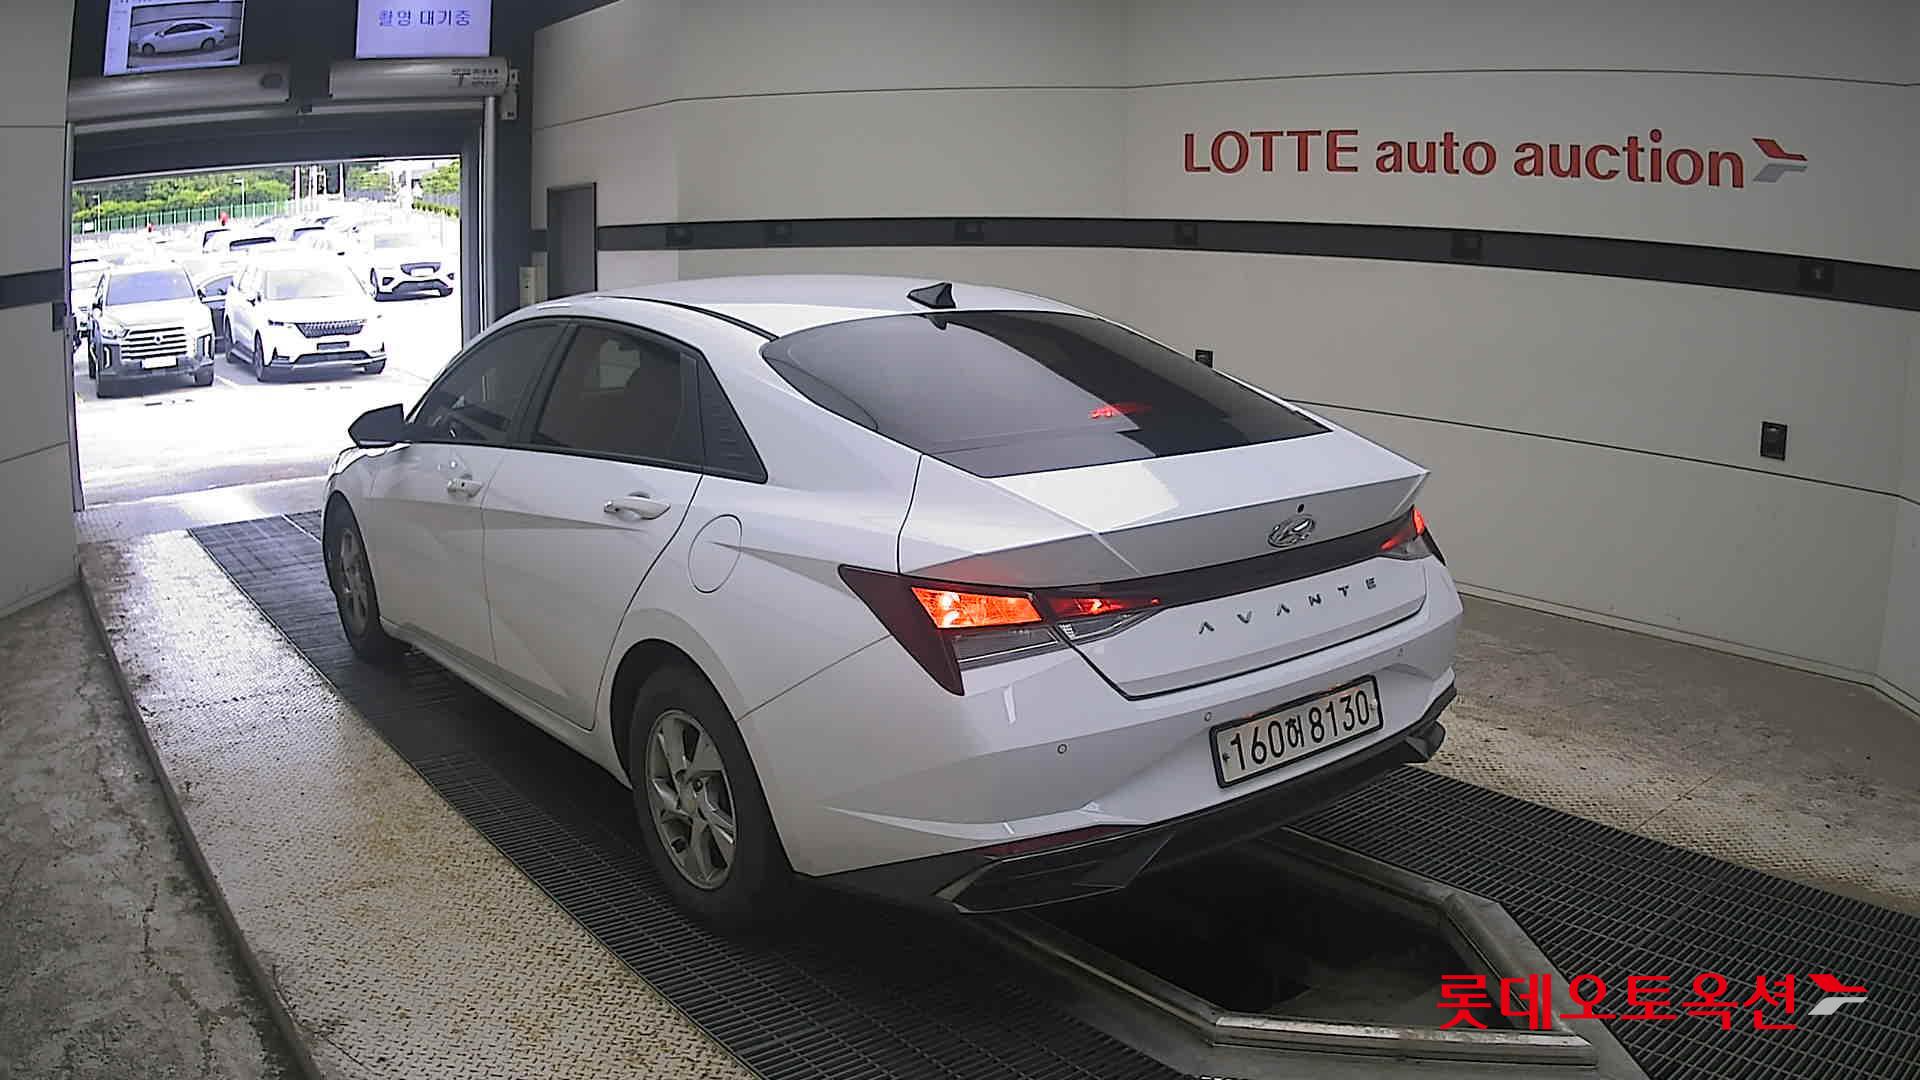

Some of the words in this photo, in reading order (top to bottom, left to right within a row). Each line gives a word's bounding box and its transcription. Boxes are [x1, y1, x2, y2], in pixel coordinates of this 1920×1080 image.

[419, 9, 472, 27] 대기중
[1184, 129, 1360, 173] LOTTE
[1375, 131, 1498, 175] auto
[1513, 128, 1745, 189] auction
[1198, 576, 1378, 635] AVANTE
[1230, 690, 1370, 771] 160허8130
